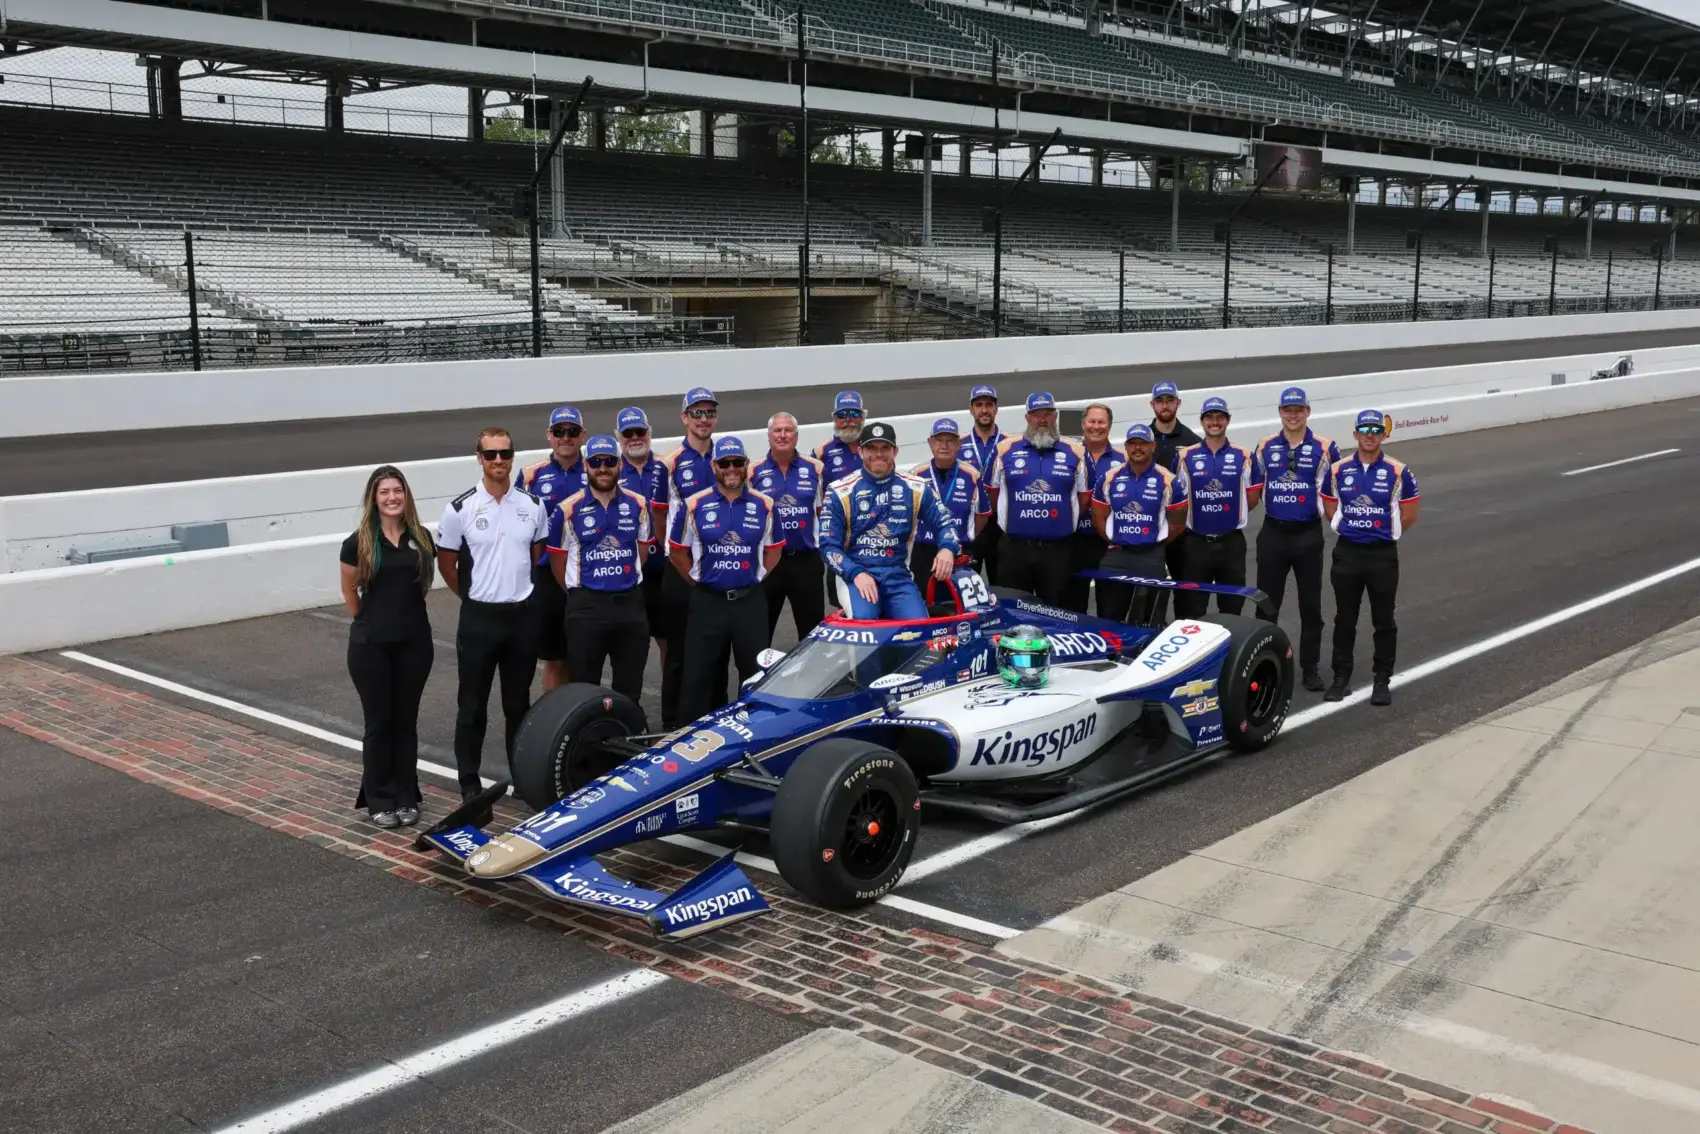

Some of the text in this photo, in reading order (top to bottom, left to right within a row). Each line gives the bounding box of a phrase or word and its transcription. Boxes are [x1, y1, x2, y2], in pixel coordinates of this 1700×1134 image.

[1394, 413, 1449, 430] Shell Renewable Race Fuel
[1268, 480, 1309, 492] Kingspan
[1014, 491, 1062, 504] Kingspan
[1195, 489, 1234, 501] Kingspan
[1272, 495, 1297, 503] ARCO
[777, 505, 808, 517] ngspan
[1020, 508, 1049, 518] ARCO
[1201, 504, 1223, 512] ARCO
[1344, 504, 1385, 516] Kingspan
[1114, 511, 1153, 522] Kingspan
[1079, 520, 1092, 529] AR
[1347, 519, 1373, 528] ARCO
[1119, 526, 1142, 534] ARCO
[856, 535, 899, 548] Kingspan
[585, 548, 632, 562] Kingspan
[858, 548, 886, 557] ARCO
[593, 565, 623, 578] ARCO
[712, 561, 740, 570] ARCO
[1107, 575, 1177, 586] ARCO
[957, 574, 989, 609] 23
[1016, 598, 1078, 622] DreyerReinbold.com
[932, 628, 948, 637] ARCO
[1047, 632, 1107, 657] ARCO
[1143, 635, 1190, 671] ARCO
[970, 649, 988, 679] 101
[969, 711, 1098, 768] Kingspan
[554, 733, 571, 799] Firestone
[843, 758, 895, 790] Firestone
